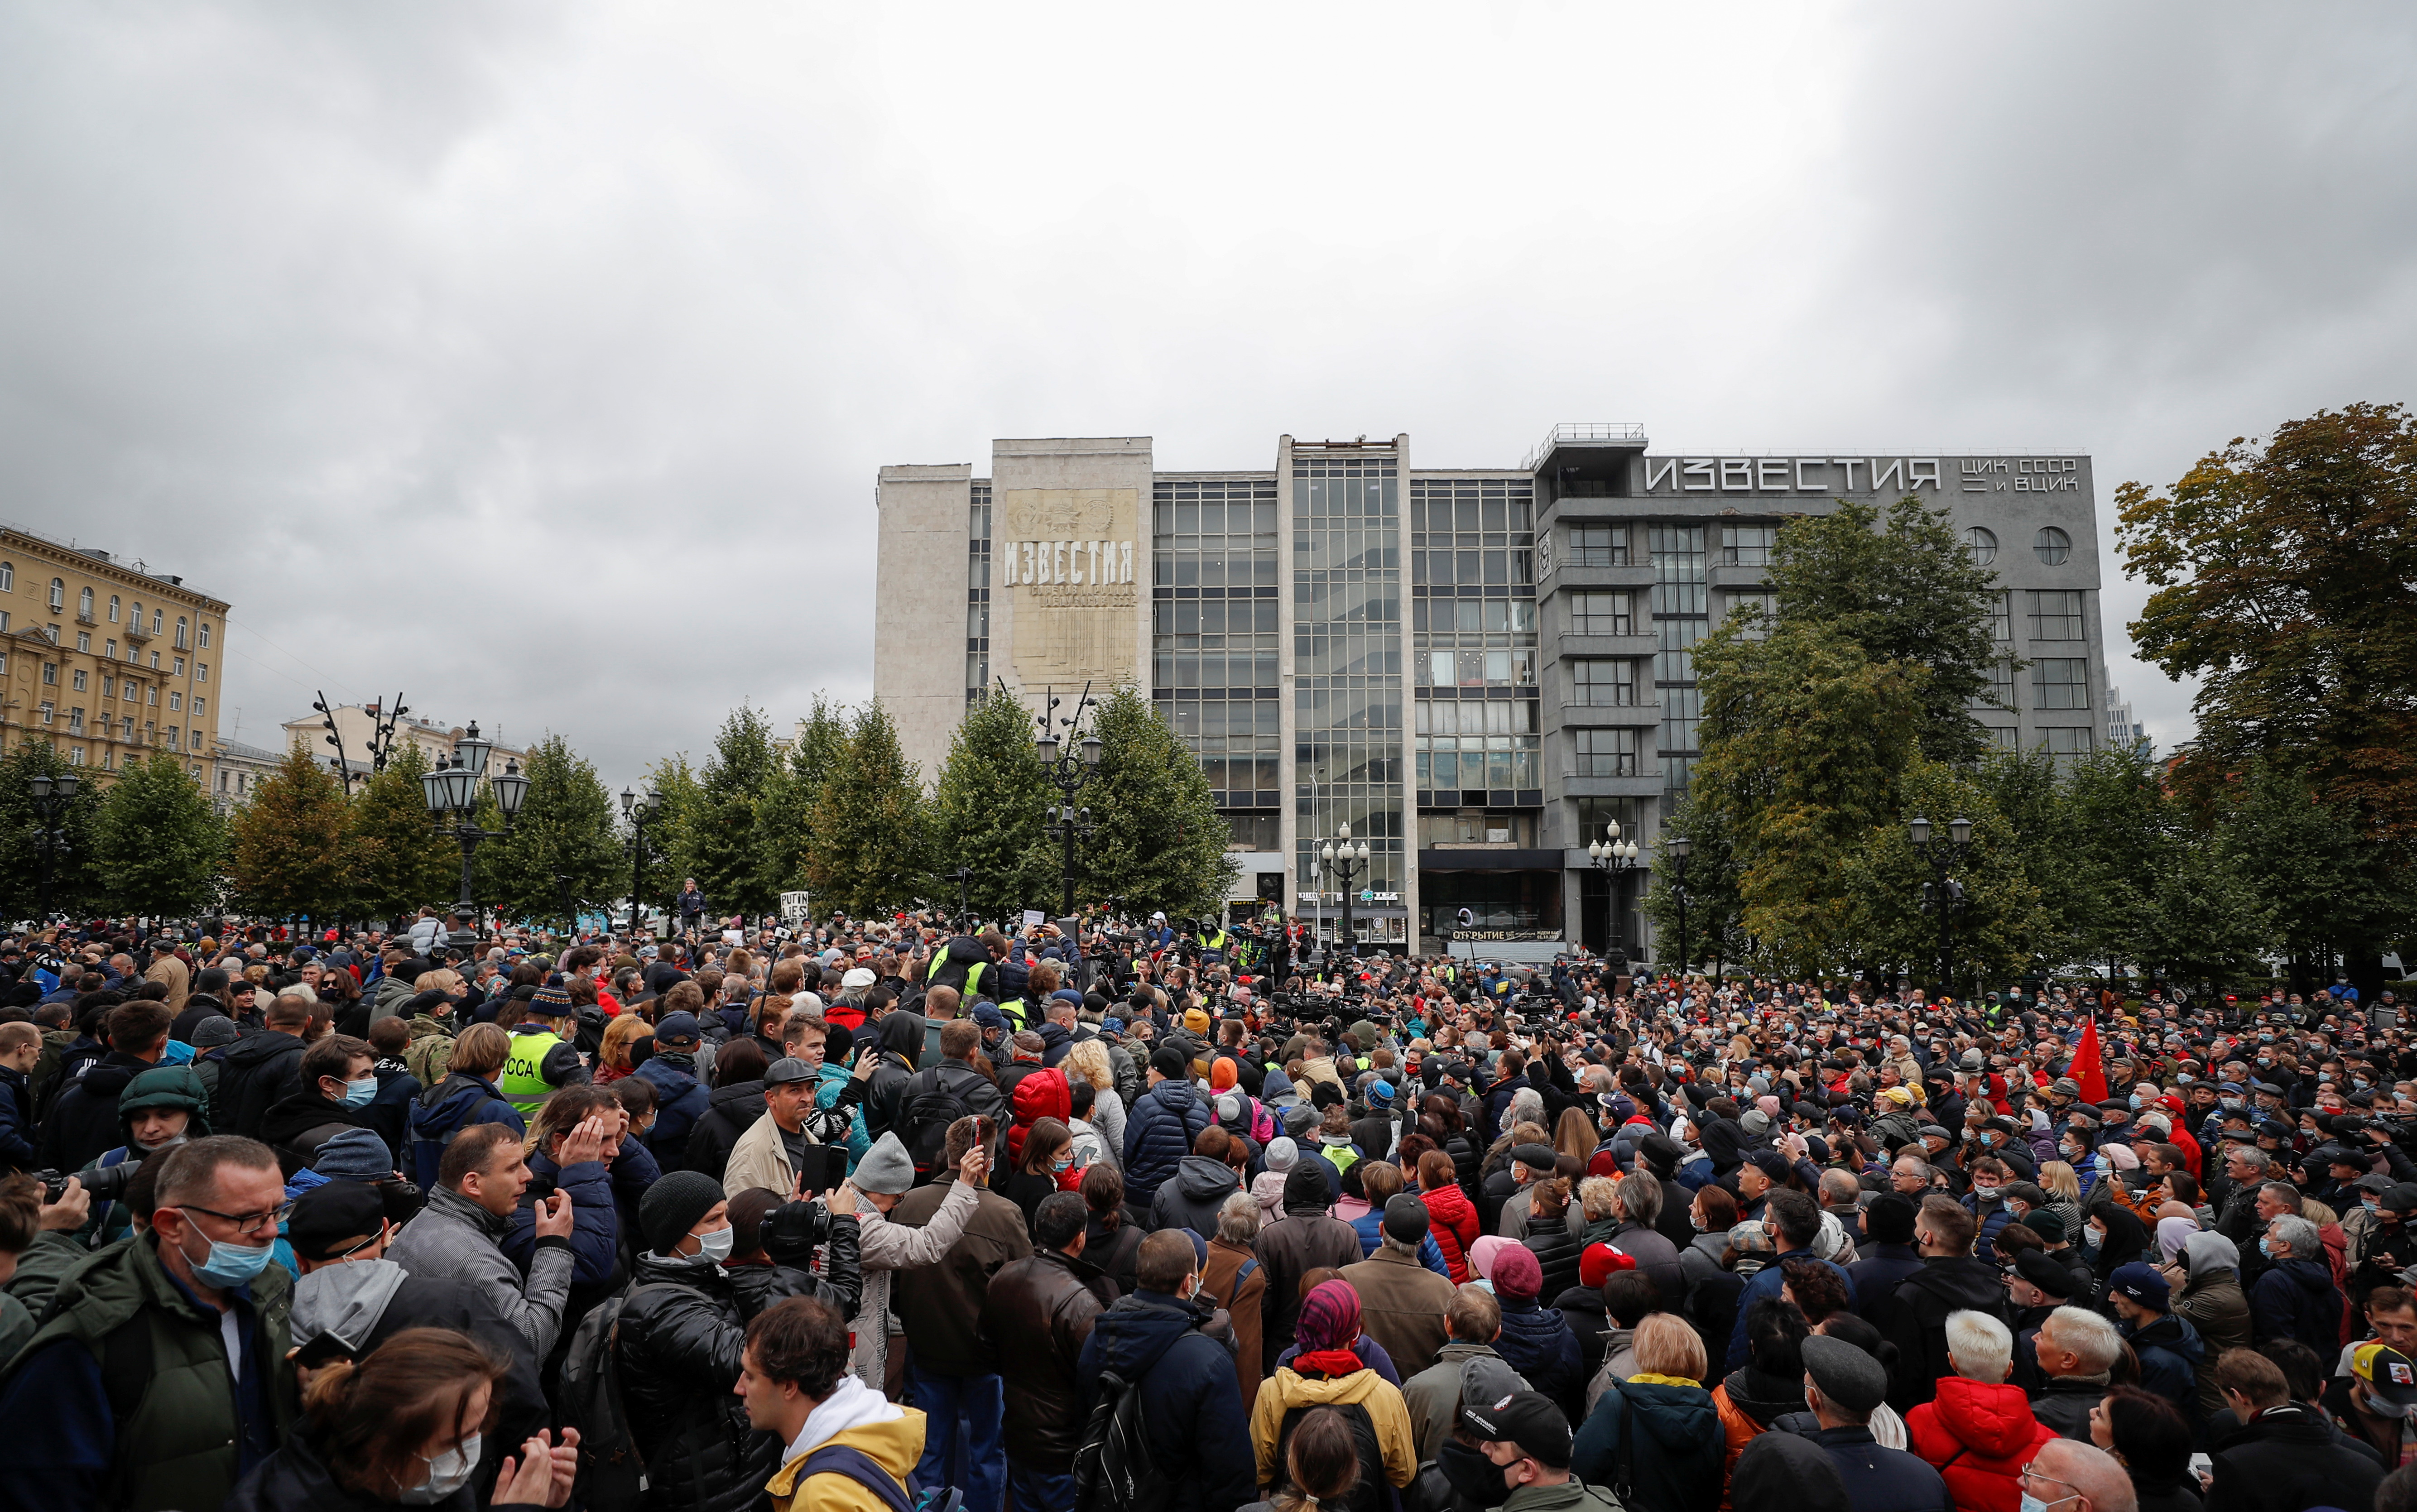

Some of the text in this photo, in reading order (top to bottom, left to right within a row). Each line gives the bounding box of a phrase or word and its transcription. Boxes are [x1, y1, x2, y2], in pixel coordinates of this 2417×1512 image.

[1645, 458, 1941, 491] ИЗВЕСТИЯ
[1961, 459, 2076, 475] ЦИК СССР
[2014, 477, 2078, 492] ВЦИК
[1004, 541, 1134, 586] ИЗВЕСТИЯ
[1453, 931, 1504, 940] ОТКРЫТИЕ
